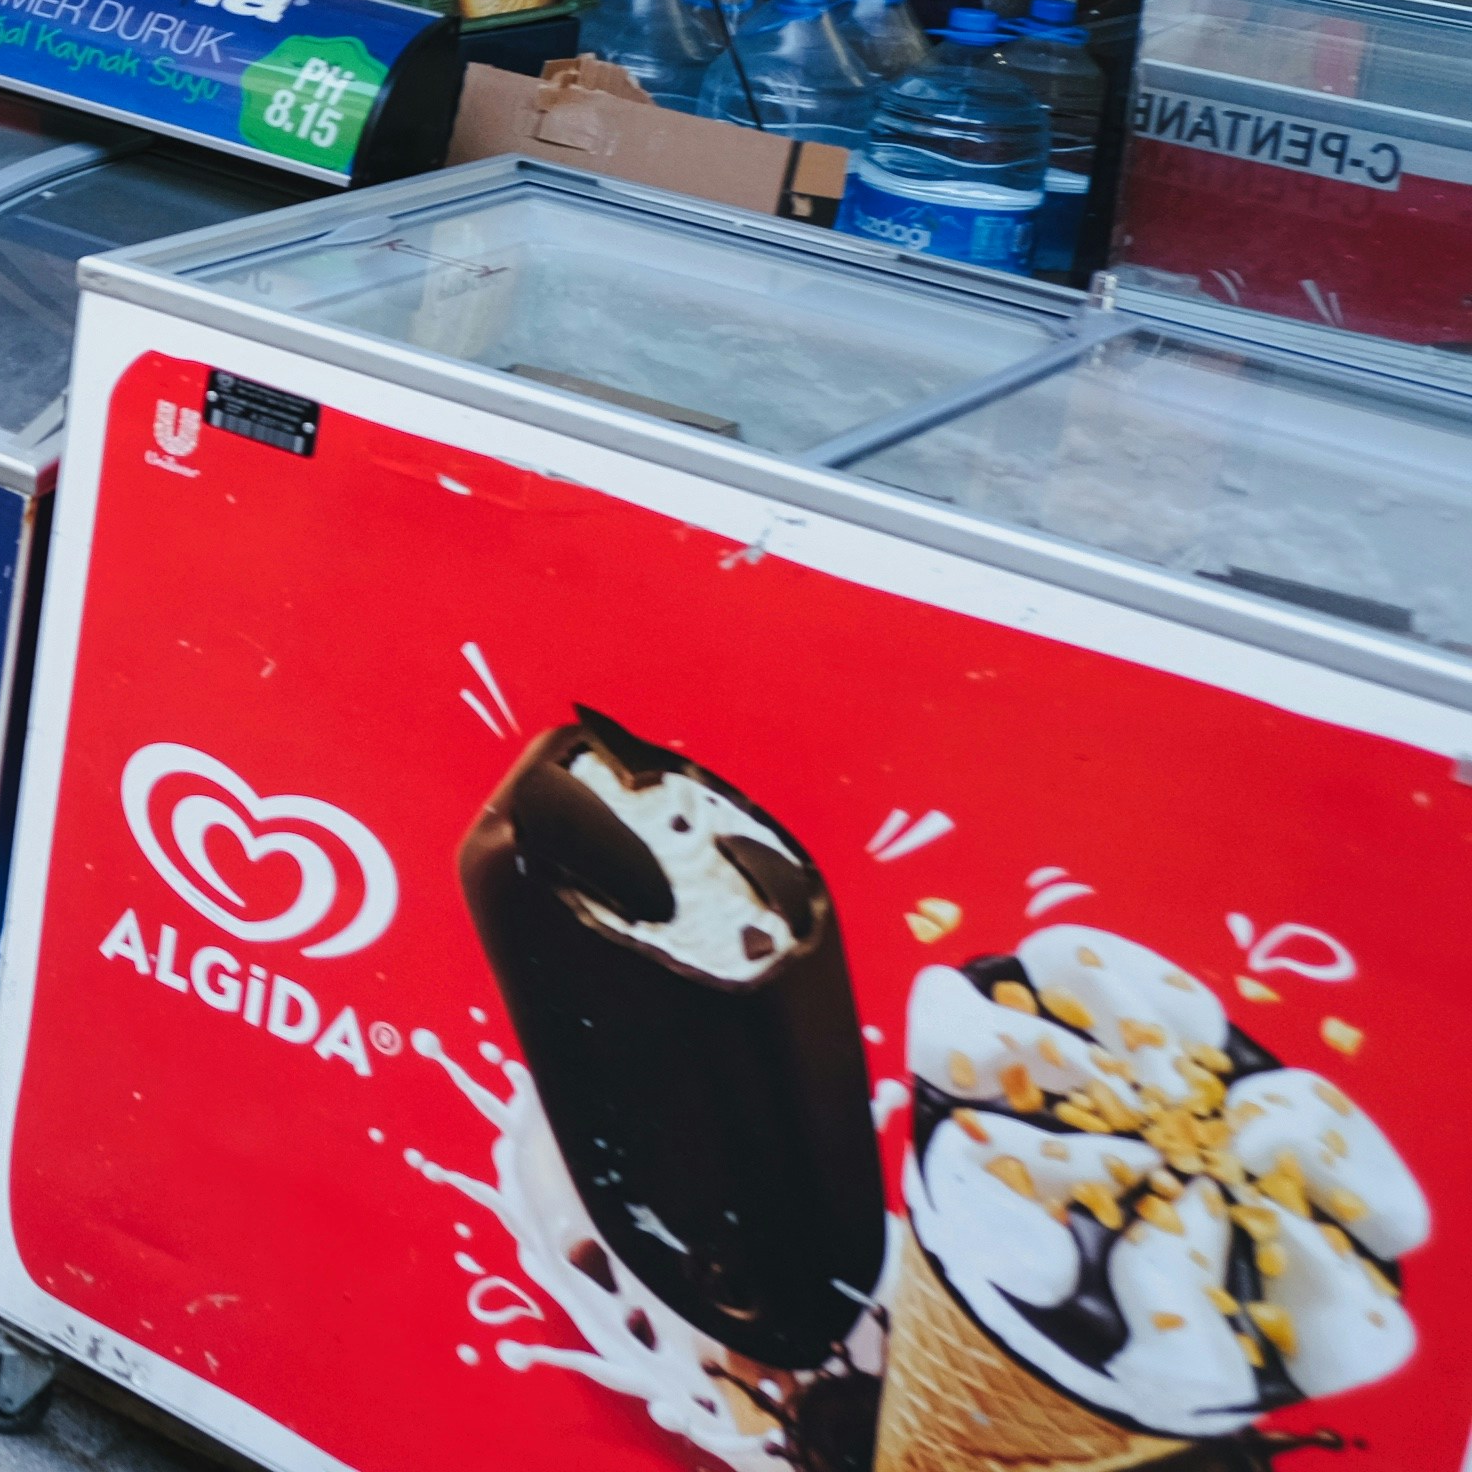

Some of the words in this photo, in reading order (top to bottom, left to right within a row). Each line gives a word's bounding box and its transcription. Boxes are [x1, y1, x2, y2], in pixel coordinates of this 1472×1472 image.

[35, 28, 139, 78] Kaynak
[148, 57, 222, 102] Suyu
[89, 0, 236, 65] DURUK
[263, 88, 343, 150] 8.15
